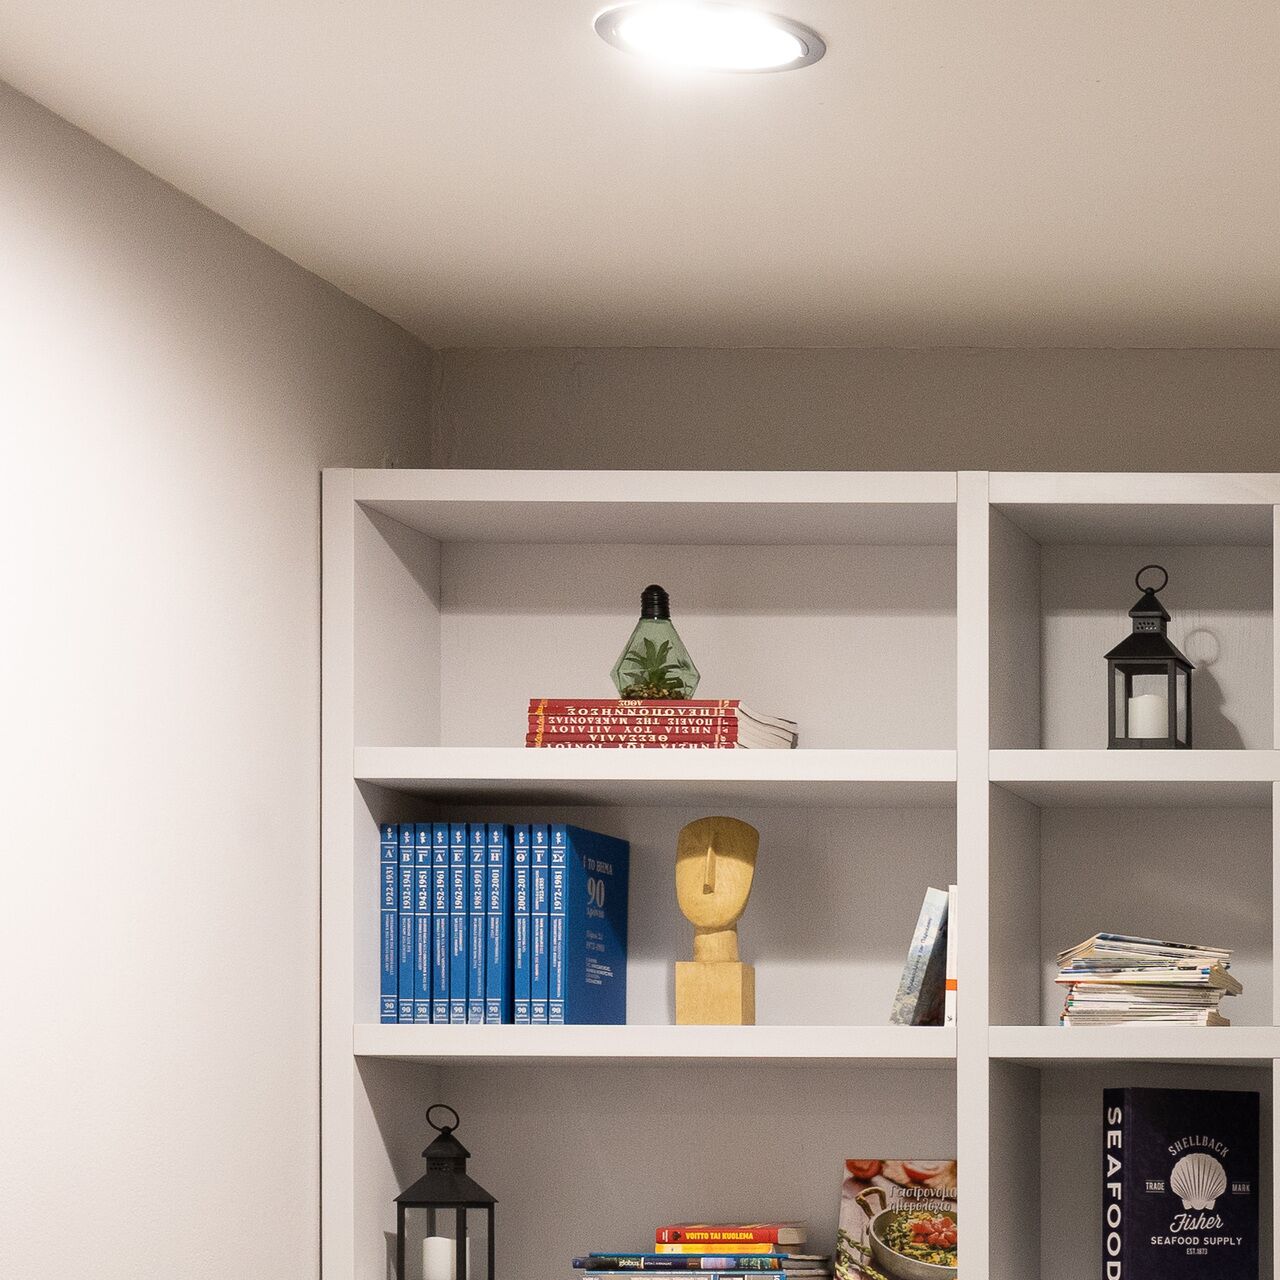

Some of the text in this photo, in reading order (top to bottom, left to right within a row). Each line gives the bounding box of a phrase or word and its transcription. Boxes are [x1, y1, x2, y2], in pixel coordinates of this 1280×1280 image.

[385, 866, 394, 906] 1922-1931
[402, 869, 412, 910] 1932-1941
[418, 870, 428, 911] 1942-1951
[436, 869, 445, 910] 1952-1961
[454, 869, 463, 910] 1962-1971
[474, 869, 483, 910] 1982-1991
[490, 869, 500, 910] 1992-2001
[517, 869, 526, 911] 2002-2011
[553, 870, 563, 910] 1972-1981
[586, 876, 606, 908] 90
[1168, 1135, 1230, 1158] SHELLBACK
[1145, 1182, 1165, 1191] TRADE
[1232, 1184, 1251, 1193] MARK
[685, 1232, 754, 1241] VOITTO TAI KUOLEMA
[1150, 1236, 1243, 1246] SEAFOOD SUPPLY
[1169, 1212, 1224, 1233] Fisher
